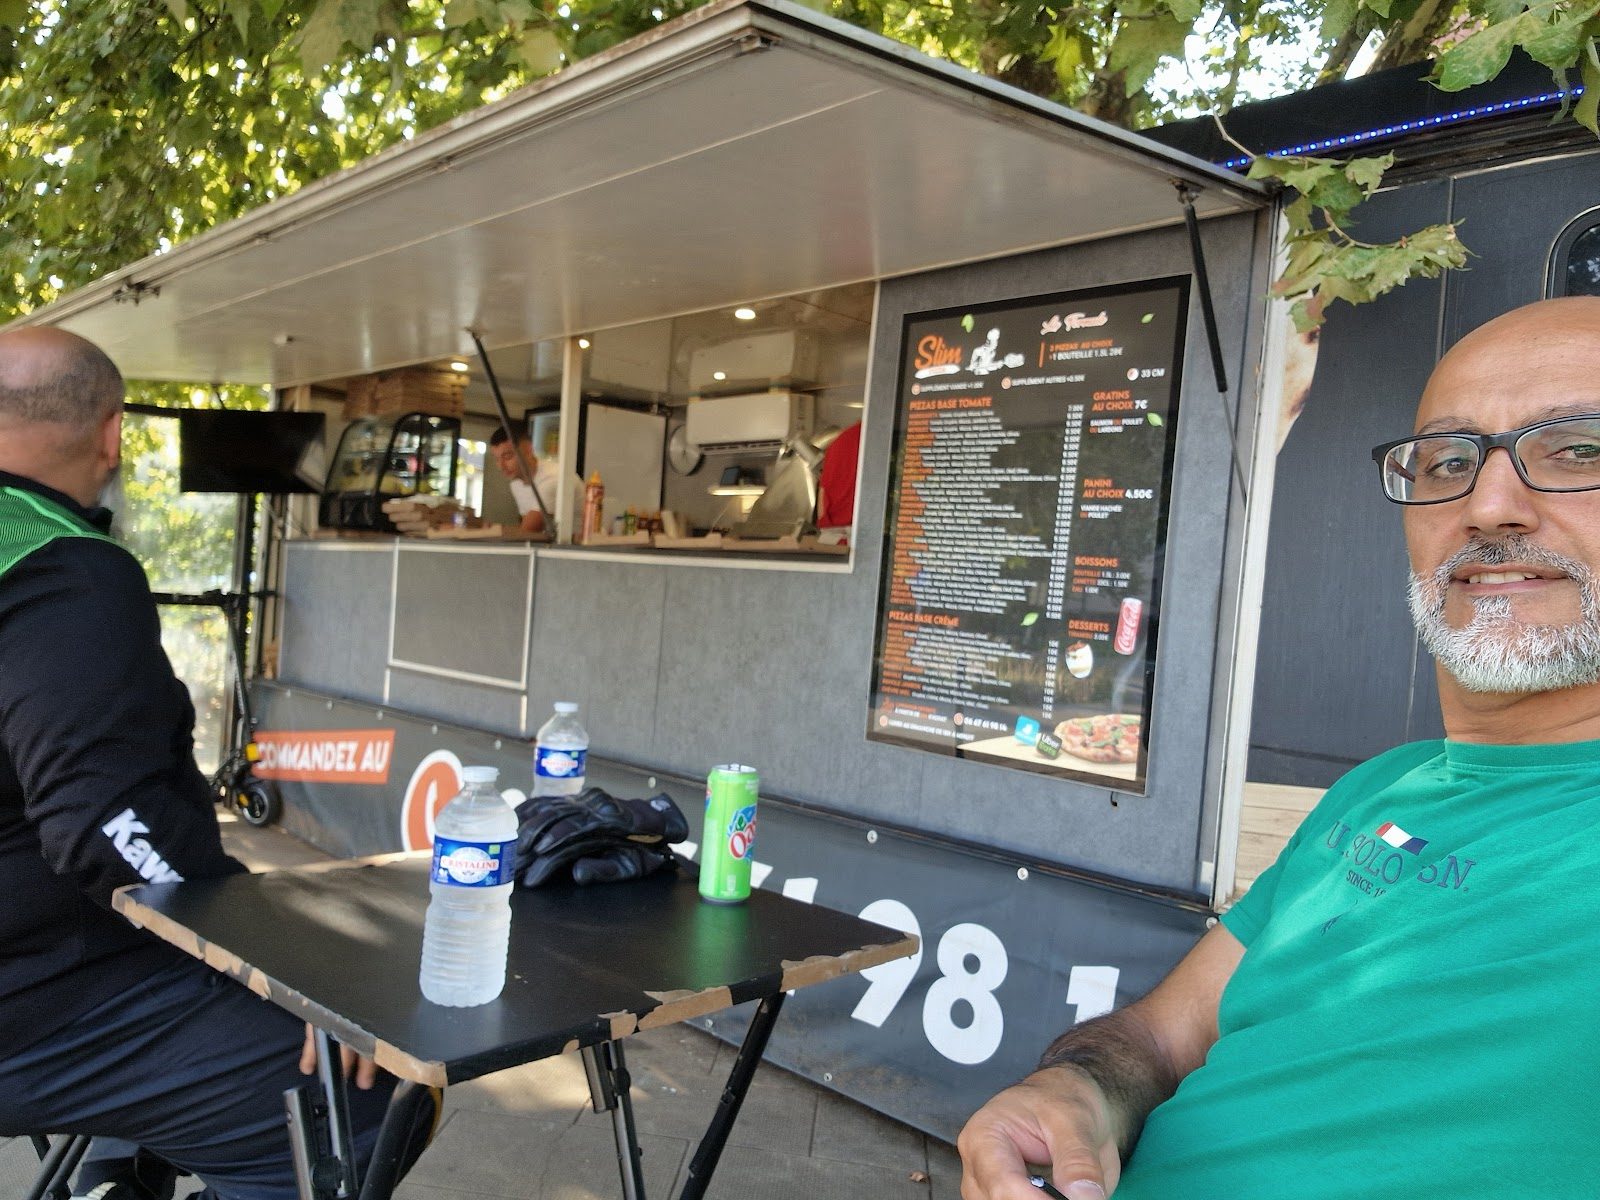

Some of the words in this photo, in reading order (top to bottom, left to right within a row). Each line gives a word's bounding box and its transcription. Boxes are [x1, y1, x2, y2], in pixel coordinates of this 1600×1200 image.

[914, 335, 962, 369] Slim
[1093, 390, 1130, 401] GRATINS
[1092, 402, 1104, 412] AU
[1105, 400, 1133, 411] CHOIX
[1083, 479, 1112, 488] PANINI
[1083, 489, 1095, 498] AU
[1096, 489, 1124, 498] CHOIX
[1074, 556, 1118, 568] BOISSONS
[1068, 619, 1110, 632] DESSERTS
[360, 739, 390, 772] AU
[1346, 869, 1374, 895] SINCE
